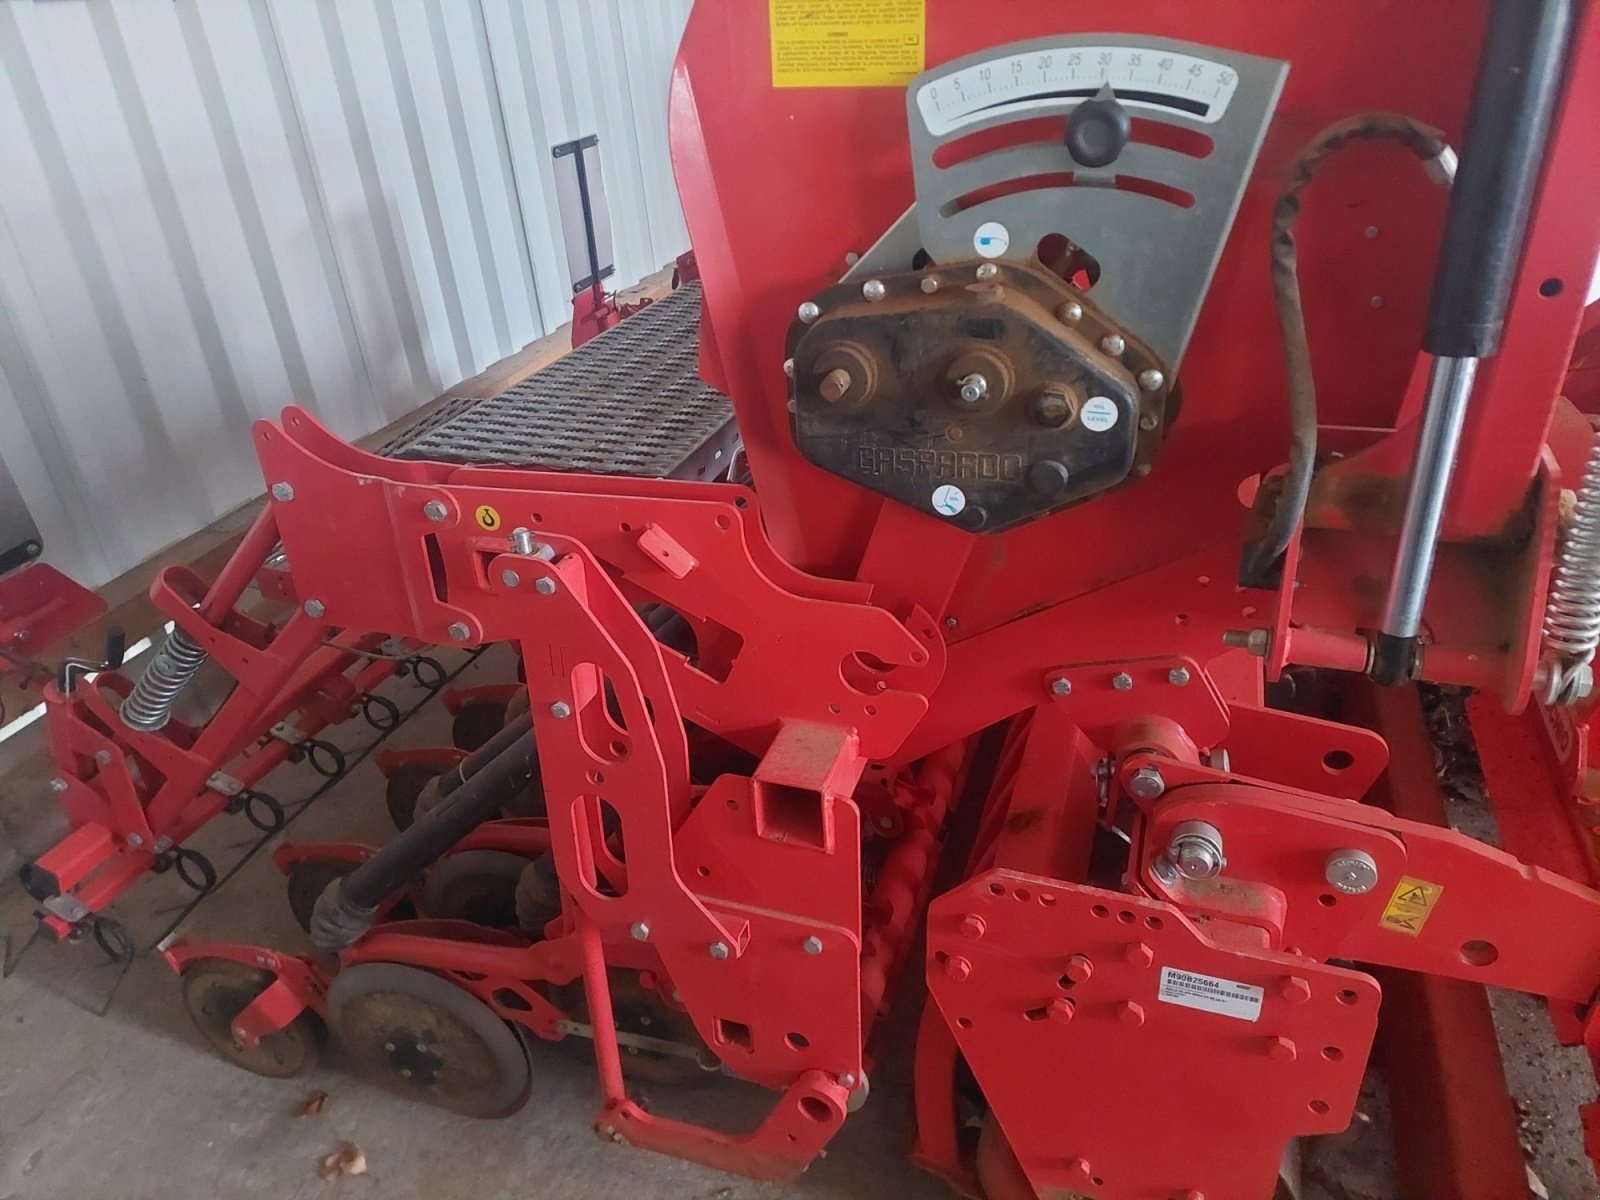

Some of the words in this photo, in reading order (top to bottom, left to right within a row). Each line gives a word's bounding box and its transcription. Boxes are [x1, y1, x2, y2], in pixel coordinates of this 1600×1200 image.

[929, 88, 938, 100] 0
[953, 78, 961, 90] 5
[979, 69, 992, 82] 10
[1011, 62, 1024, 74] 15
[1038, 56, 1053, 69] 20
[1067, 53, 1082, 65] 25
[1097, 52, 1112, 65] 30
[1127, 53, 1142, 66] 35
[1157, 57, 1174, 71] 40
[1187, 63, 1205, 77] 45
[1216, 70, 1234, 86] 50
[858, 446, 1022, 483] GASPARDO
